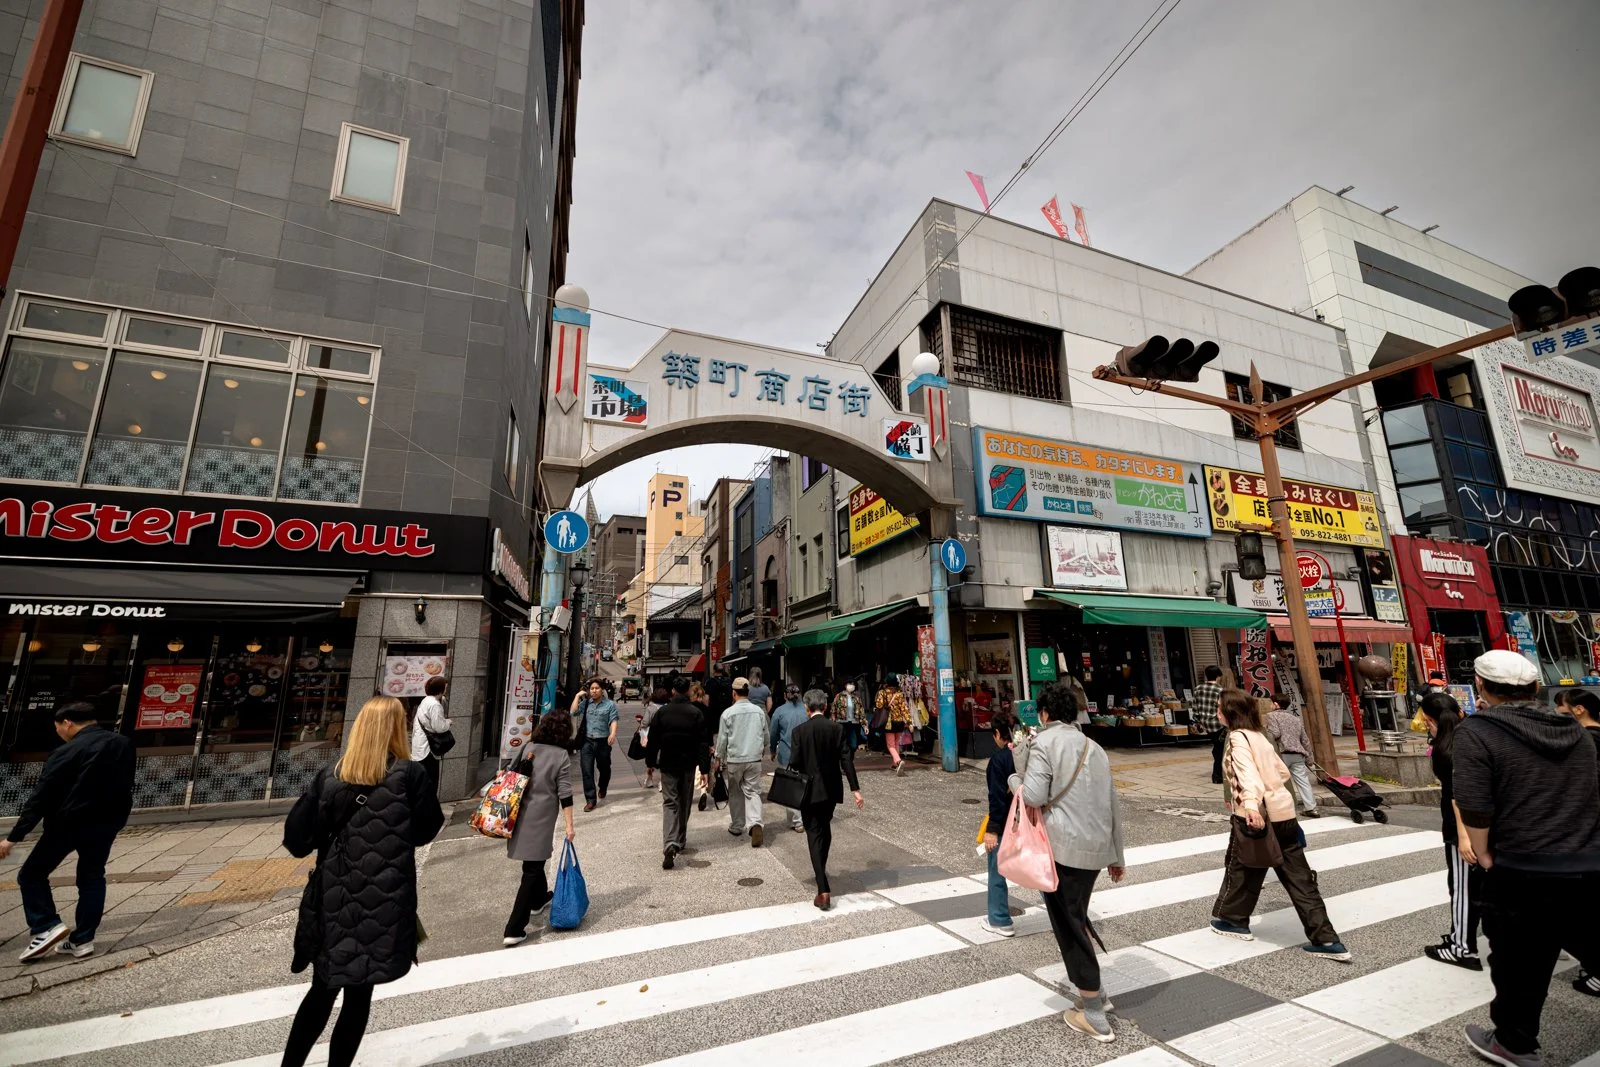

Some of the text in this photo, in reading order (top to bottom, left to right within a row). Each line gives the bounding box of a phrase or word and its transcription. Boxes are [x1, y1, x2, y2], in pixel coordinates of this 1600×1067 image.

[661, 350, 872, 417] 築町商店街
[1511, 377, 1592, 429] Marumitsu
[1549, 432, 1579, 460] in
[987, 437, 1183, 481] あなたの気持ち、 カタチにします。
[650, 490, 682, 511] P P
[852, 487, 877, 511] 全身も
[1047, 500, 1072, 510] かねとき
[1138, 483, 1184, 511] かねとき
[1193, 516, 1203, 528] 3F
[218, 509, 435, 558] Donut
[1300, 528, 1352, 542] 095-822-4881
[1298, 565, 1320, 579] 火栓
[1419, 548, 1475, 577] Marumitsu
[1374, 589, 1385, 601] 2F
[1444, 582, 1465, 600] in
[8, 603, 167, 618] Mister Donut
[1251, 599, 1272, 608] YEBISU
[1245, 644, 1271, 698] おでん
